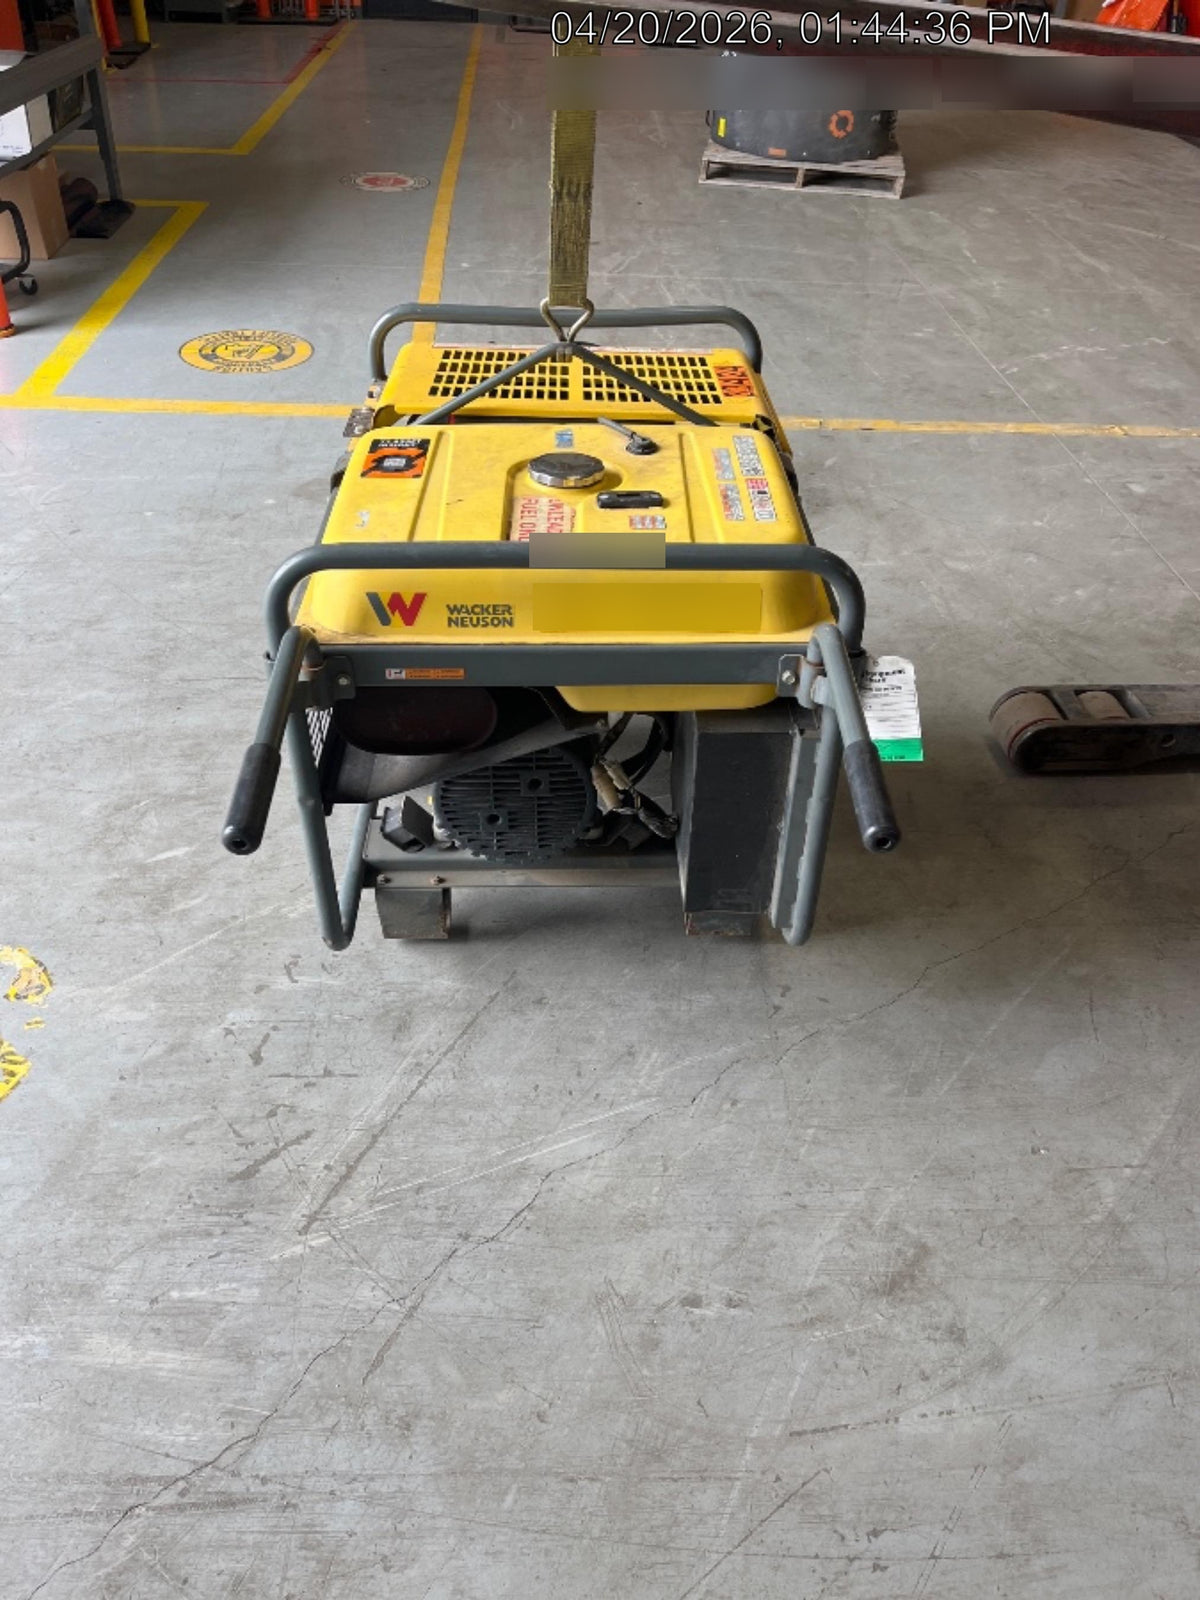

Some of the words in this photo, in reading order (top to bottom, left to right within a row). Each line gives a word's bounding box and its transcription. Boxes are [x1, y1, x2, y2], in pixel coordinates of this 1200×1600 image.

[520, 496, 538, 520] FUEL
[446, 604, 513, 616] WACKER
[447, 616, 514, 628] NEUSON
